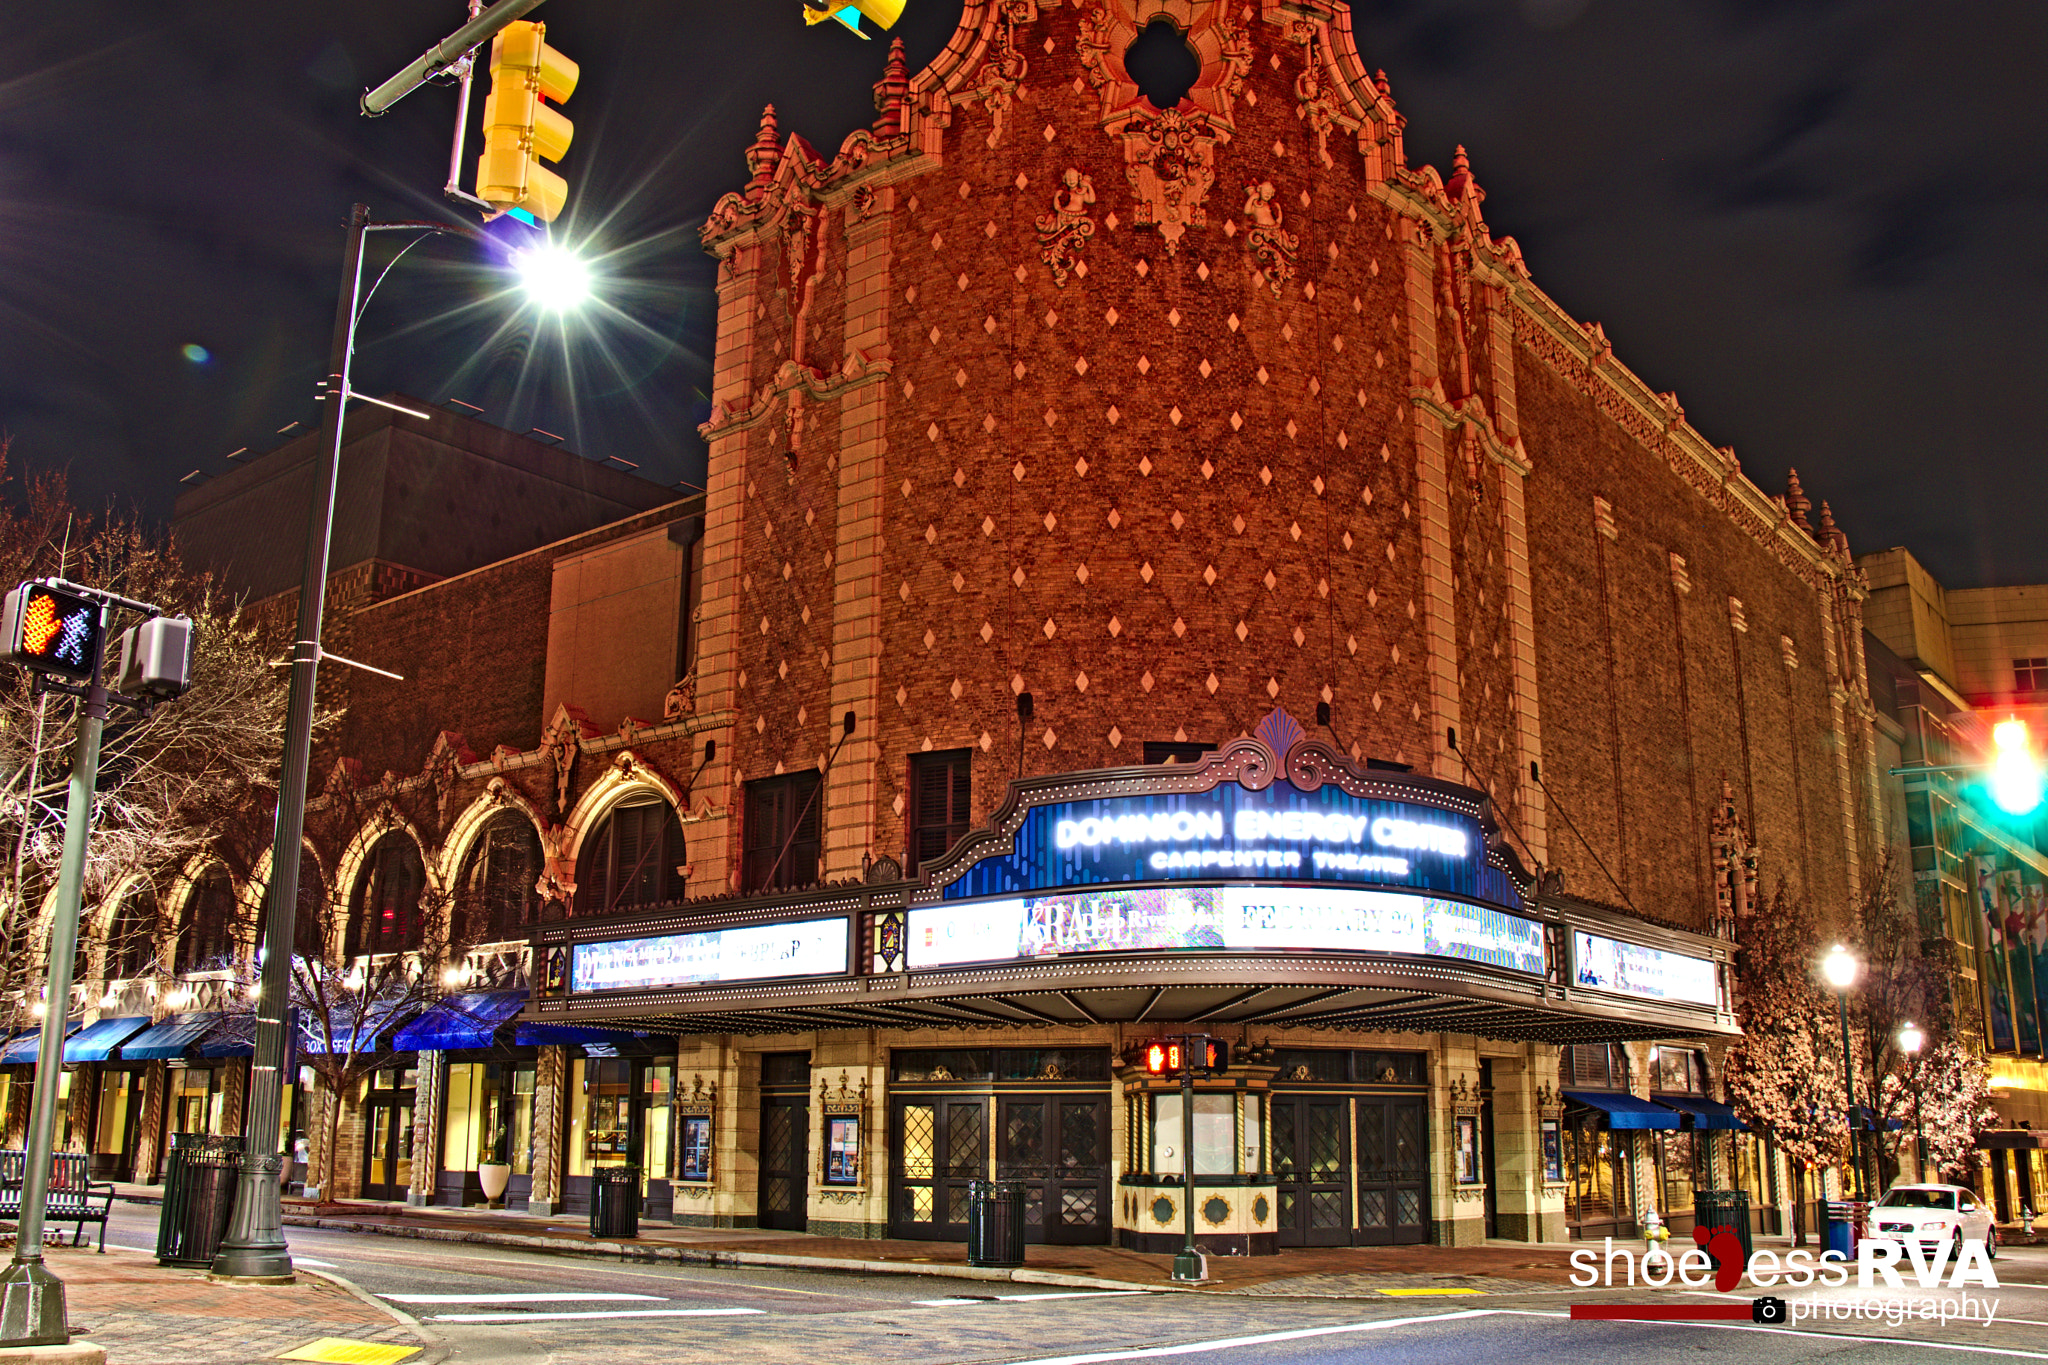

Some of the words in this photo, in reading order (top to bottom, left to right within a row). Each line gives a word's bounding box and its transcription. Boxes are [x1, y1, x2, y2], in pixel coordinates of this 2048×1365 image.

[1057, 812, 1223, 848] DOMINION
[1236, 810, 1367, 843] ENERGY
[1372, 818, 1467, 857] CENTER
[1151, 850, 1300, 869] CARPENTER
[1313, 851, 1409, 874] THEATRE
[304, 1040, 322, 1054] BOX
